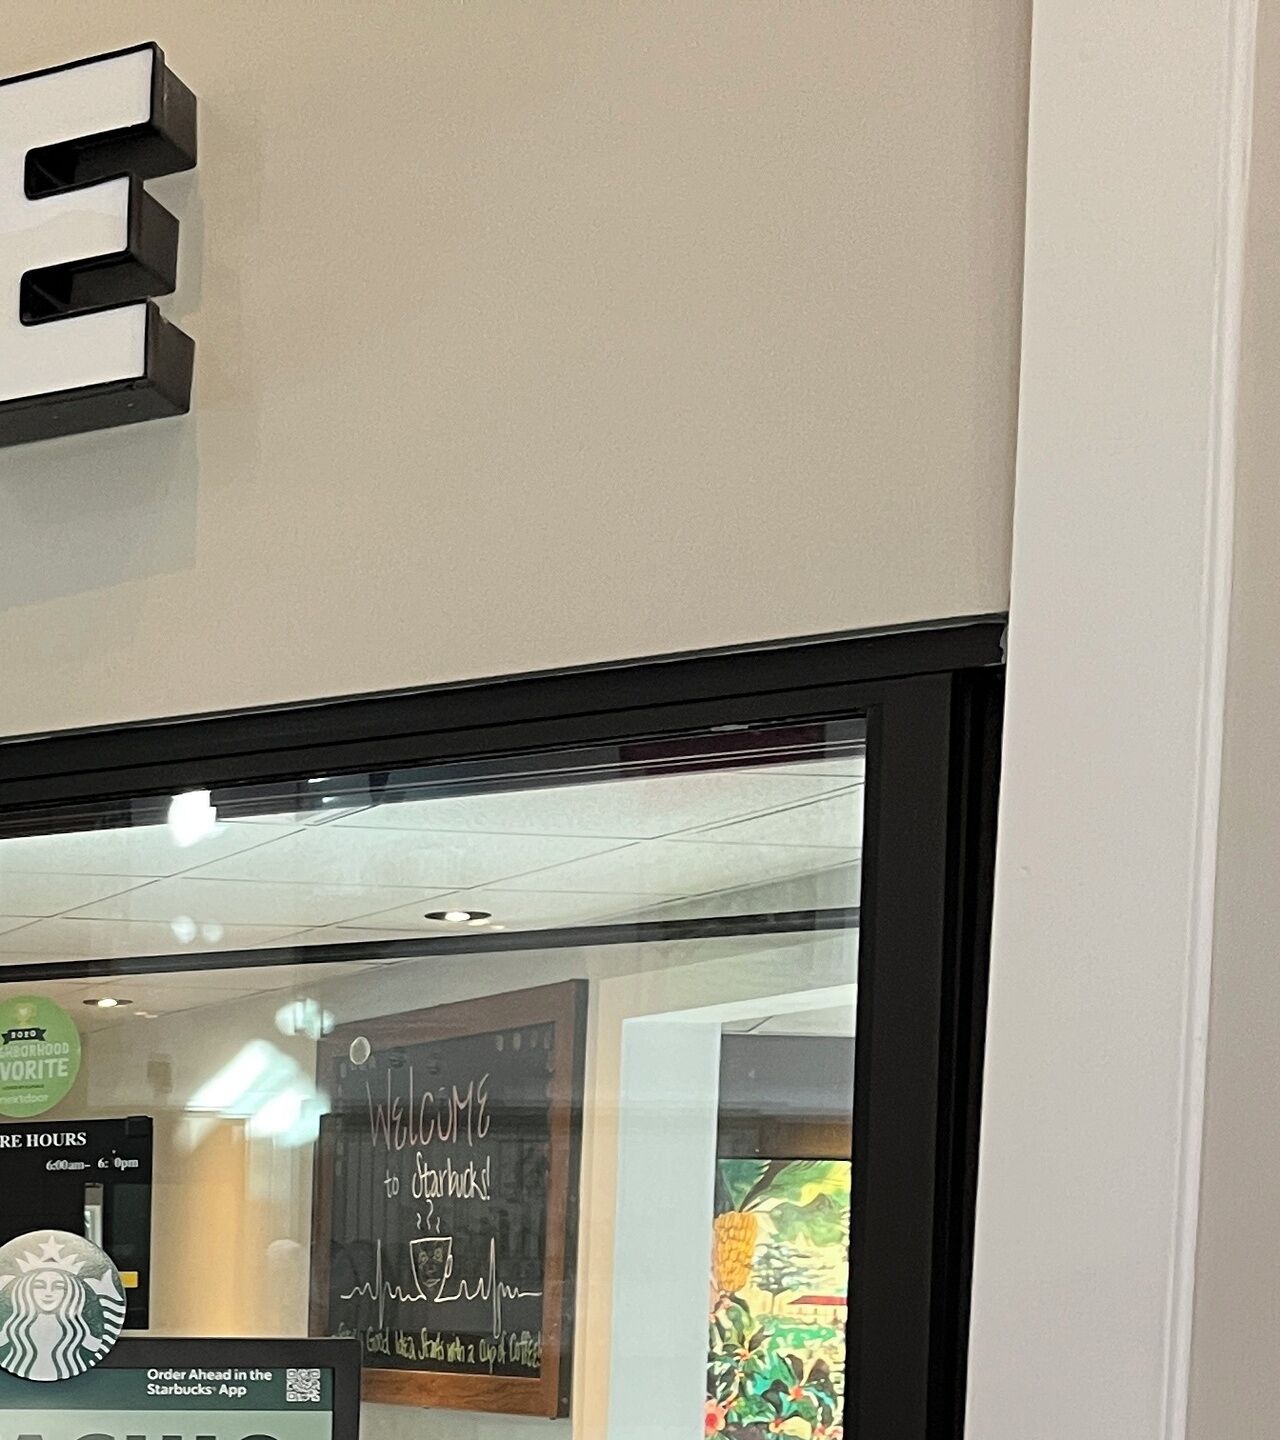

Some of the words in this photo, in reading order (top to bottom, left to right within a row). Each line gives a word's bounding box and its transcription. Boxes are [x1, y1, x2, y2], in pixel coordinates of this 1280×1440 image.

[26, 1132, 87, 1147] HOURS
[384, 1169, 400, 1198] to
[147, 1368, 187, 1381] Order
[189, 1368, 232, 1381] Ahead
[234, 1368, 247, 1381] in
[249, 1368, 273, 1381] the
[218, 1384, 248, 1398] App
